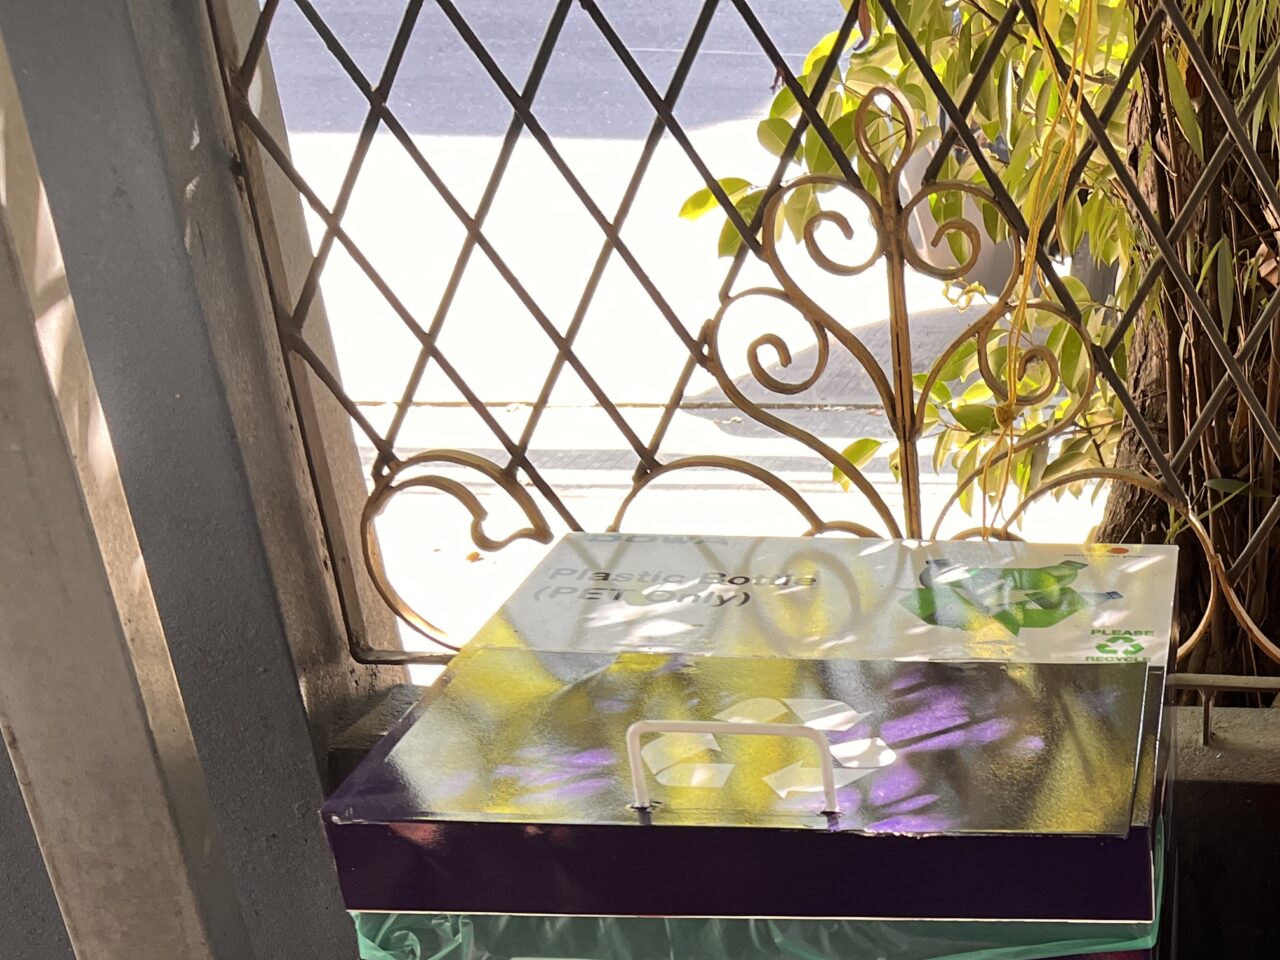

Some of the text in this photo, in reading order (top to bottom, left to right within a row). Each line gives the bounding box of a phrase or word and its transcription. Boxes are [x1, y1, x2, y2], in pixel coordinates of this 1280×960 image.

[550, 568, 816, 586] Plastic Bottle
[534, 586, 750, 607] (PET Only)
